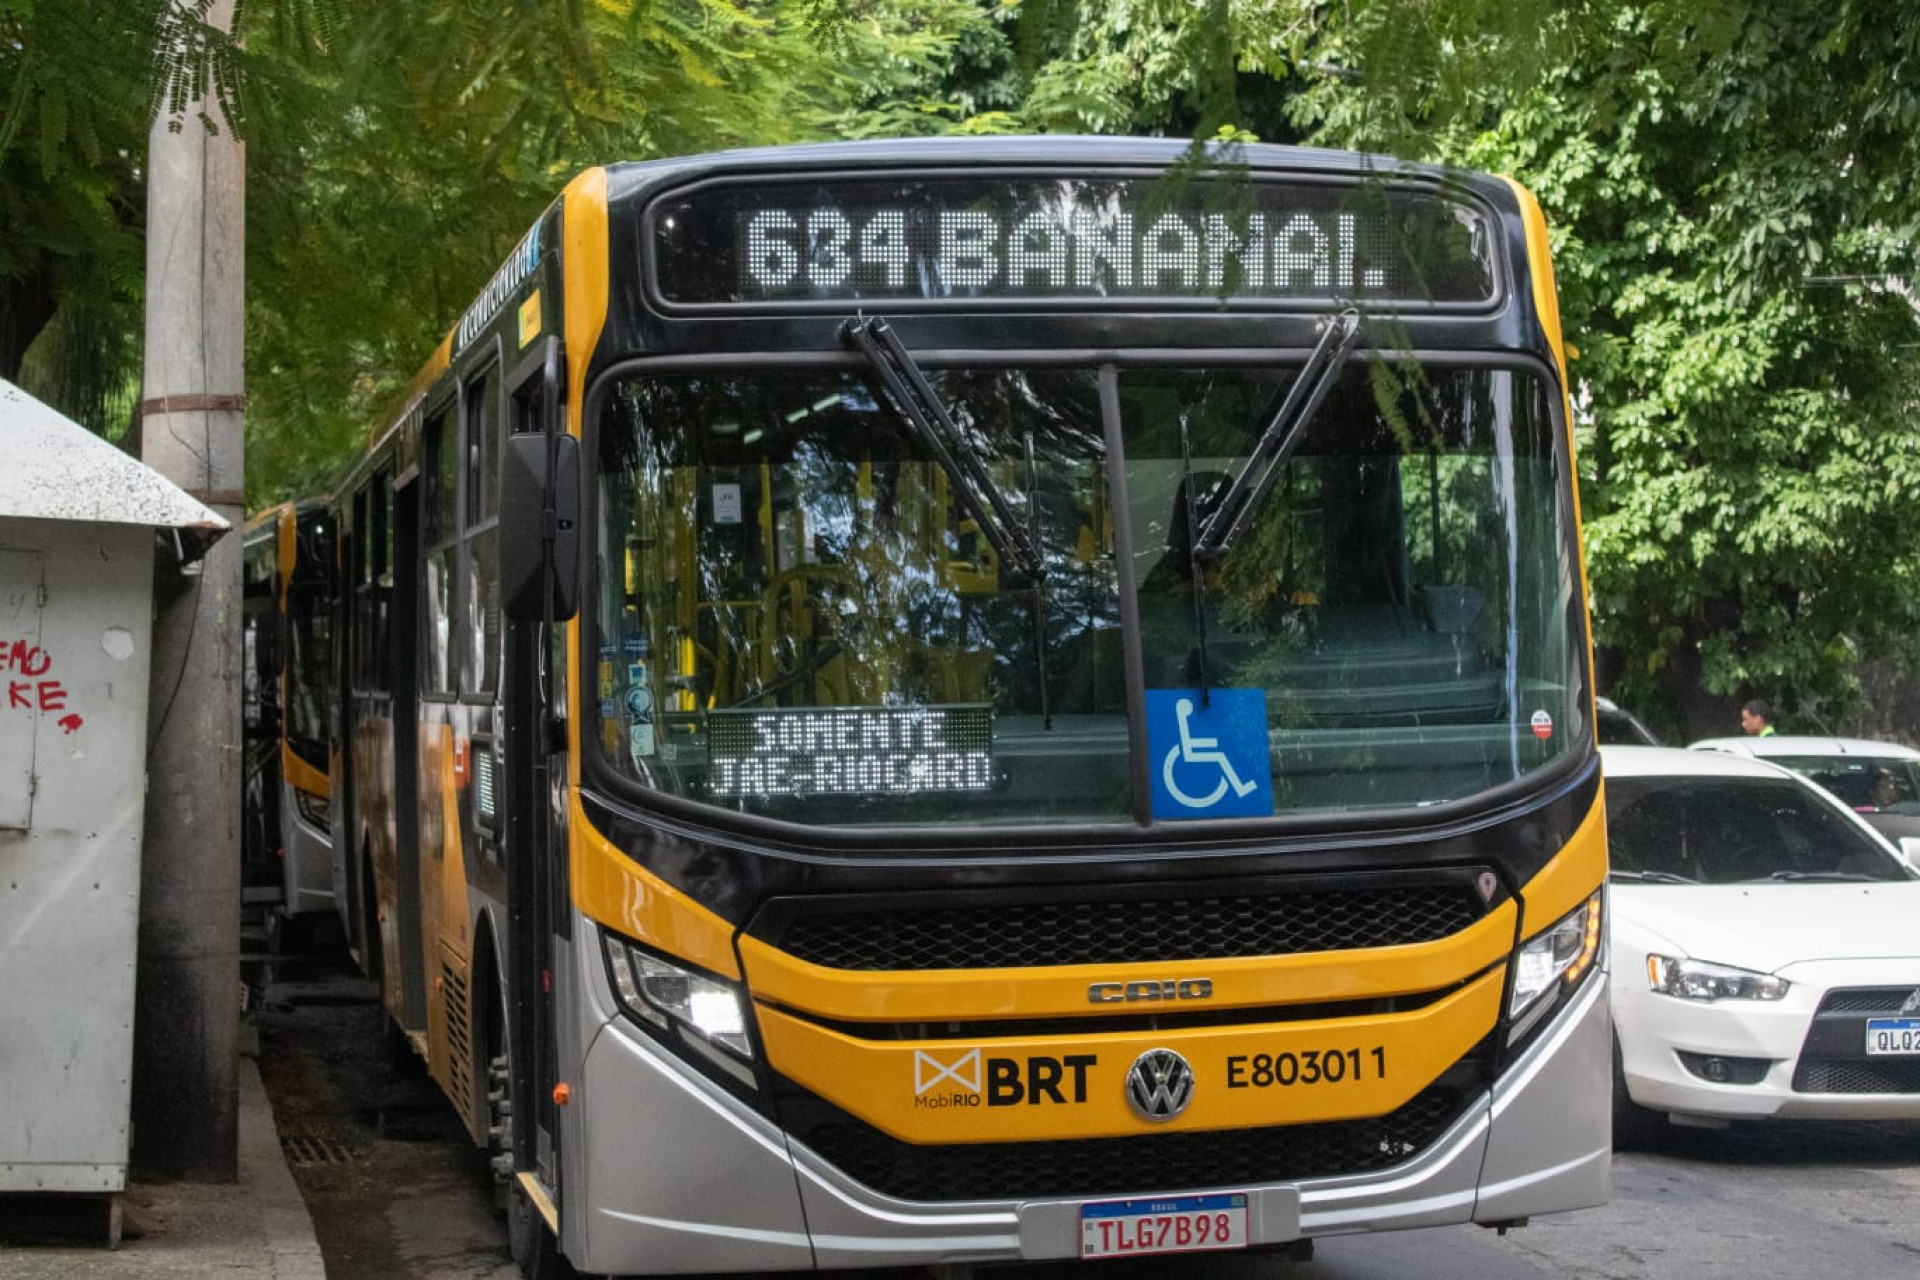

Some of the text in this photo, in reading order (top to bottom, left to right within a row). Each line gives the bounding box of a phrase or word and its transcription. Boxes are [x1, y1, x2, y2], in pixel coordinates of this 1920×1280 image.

[749, 210, 909, 286] 634
[753, 711, 946, 751] SOMENTE
[710, 752, 990, 794] JAE-RIOCARD
[1089, 978, 1213, 1003] CAIO
[987, 1054, 1097, 1107] BRT
[1227, 1045, 1385, 1089] E803011
[914, 1093, 981, 1110] MobiRIO
[1098, 1213, 1231, 1251] TLG7B98
